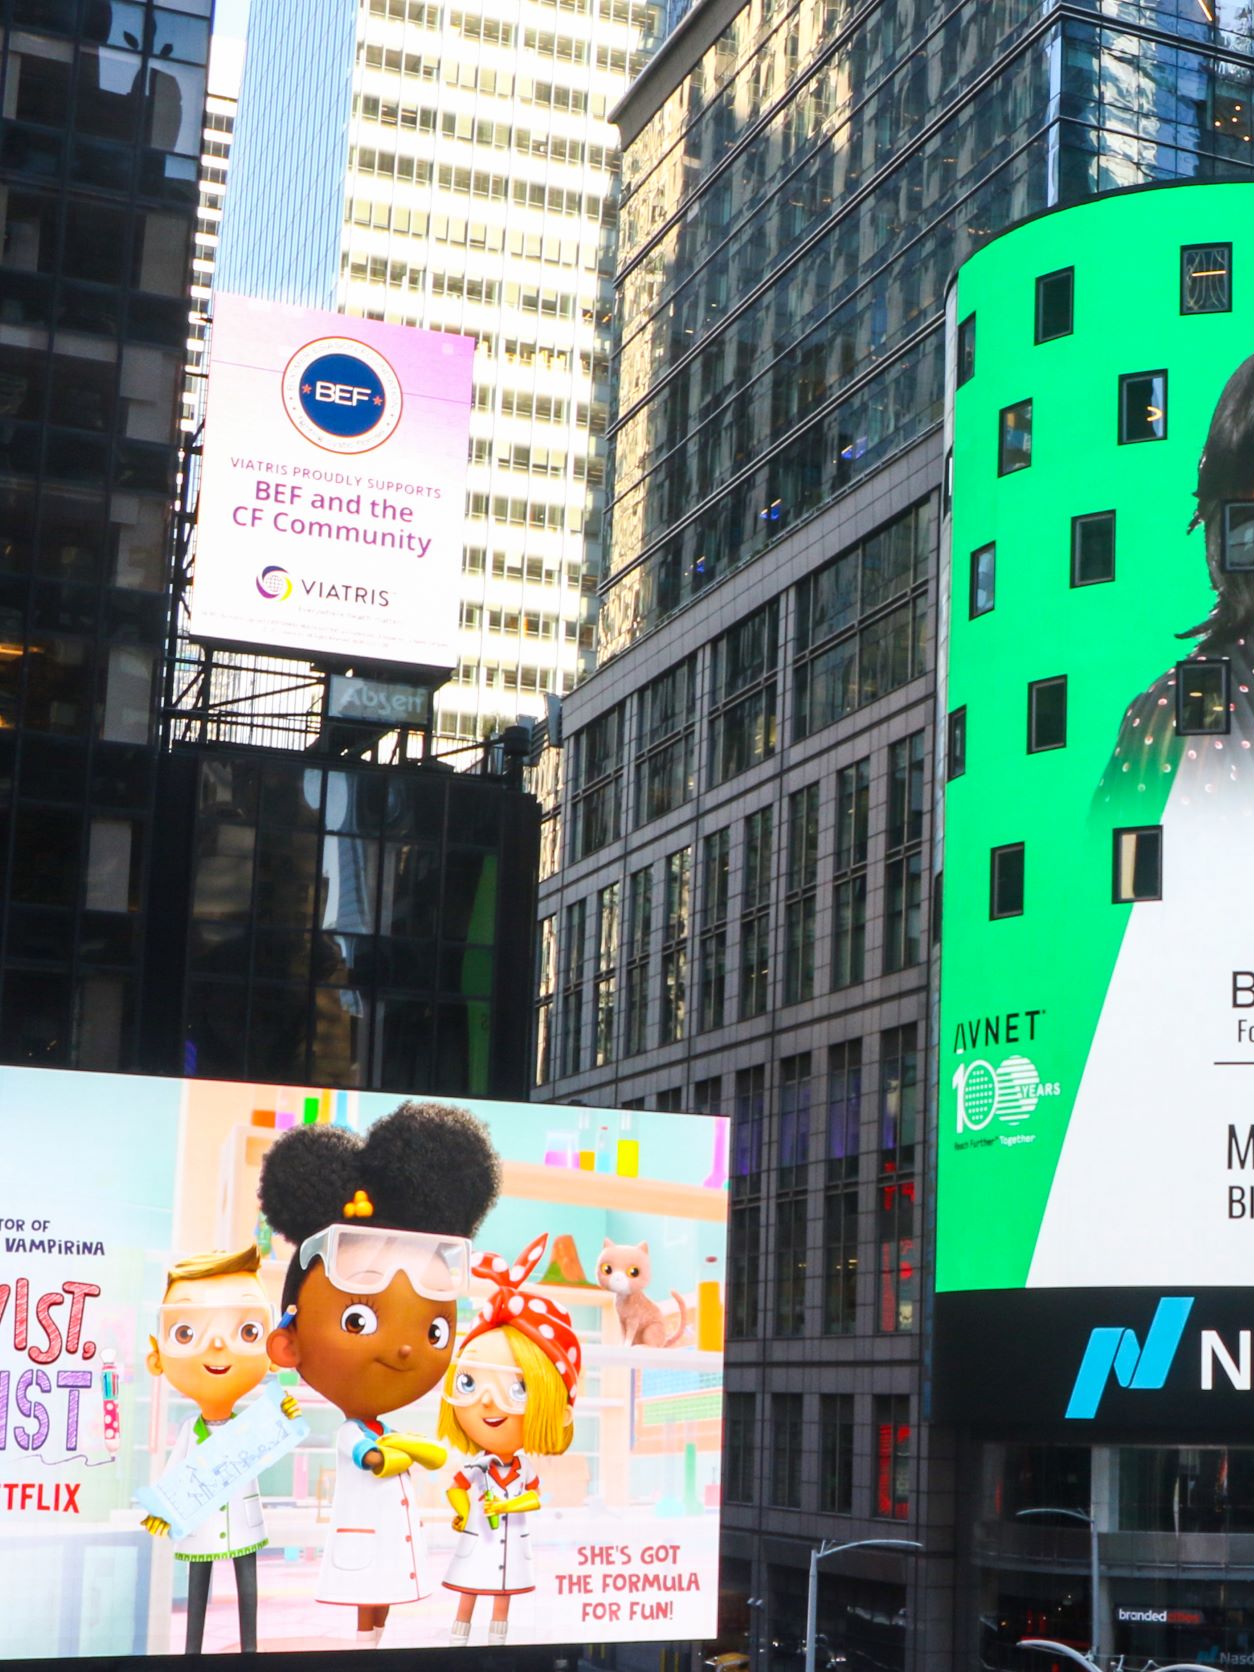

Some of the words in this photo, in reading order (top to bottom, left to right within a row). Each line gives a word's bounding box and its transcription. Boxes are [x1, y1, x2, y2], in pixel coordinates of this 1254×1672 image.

[315, 380, 372, 407] BEF
[230, 457, 288, 476] VIATRIS
[293, 467, 362, 488] PROUDLY
[367, 478, 442, 500] SUPPORTS
[255, 480, 303, 506] BEF
[311, 485, 361, 516] and
[370, 498, 414, 523] the
[232, 505, 264, 528] CF
[273, 512, 432, 558] Community
[301, 578, 390, 608] VIATRIS
[954, 1009, 1041, 1055] AVNET
[1021, 1082, 1061, 1099] YEARS
[31, 1219, 51, 1233] OF
[0, 1483, 81, 1513] TFLIX
[577, 1545, 632, 1566] SHE'S
[640, 1545, 681, 1565] GOT
[555, 1574, 593, 1595] THE
[602, 1573, 700, 1593] FORMULA
[582, 1602, 621, 1622] FOR
